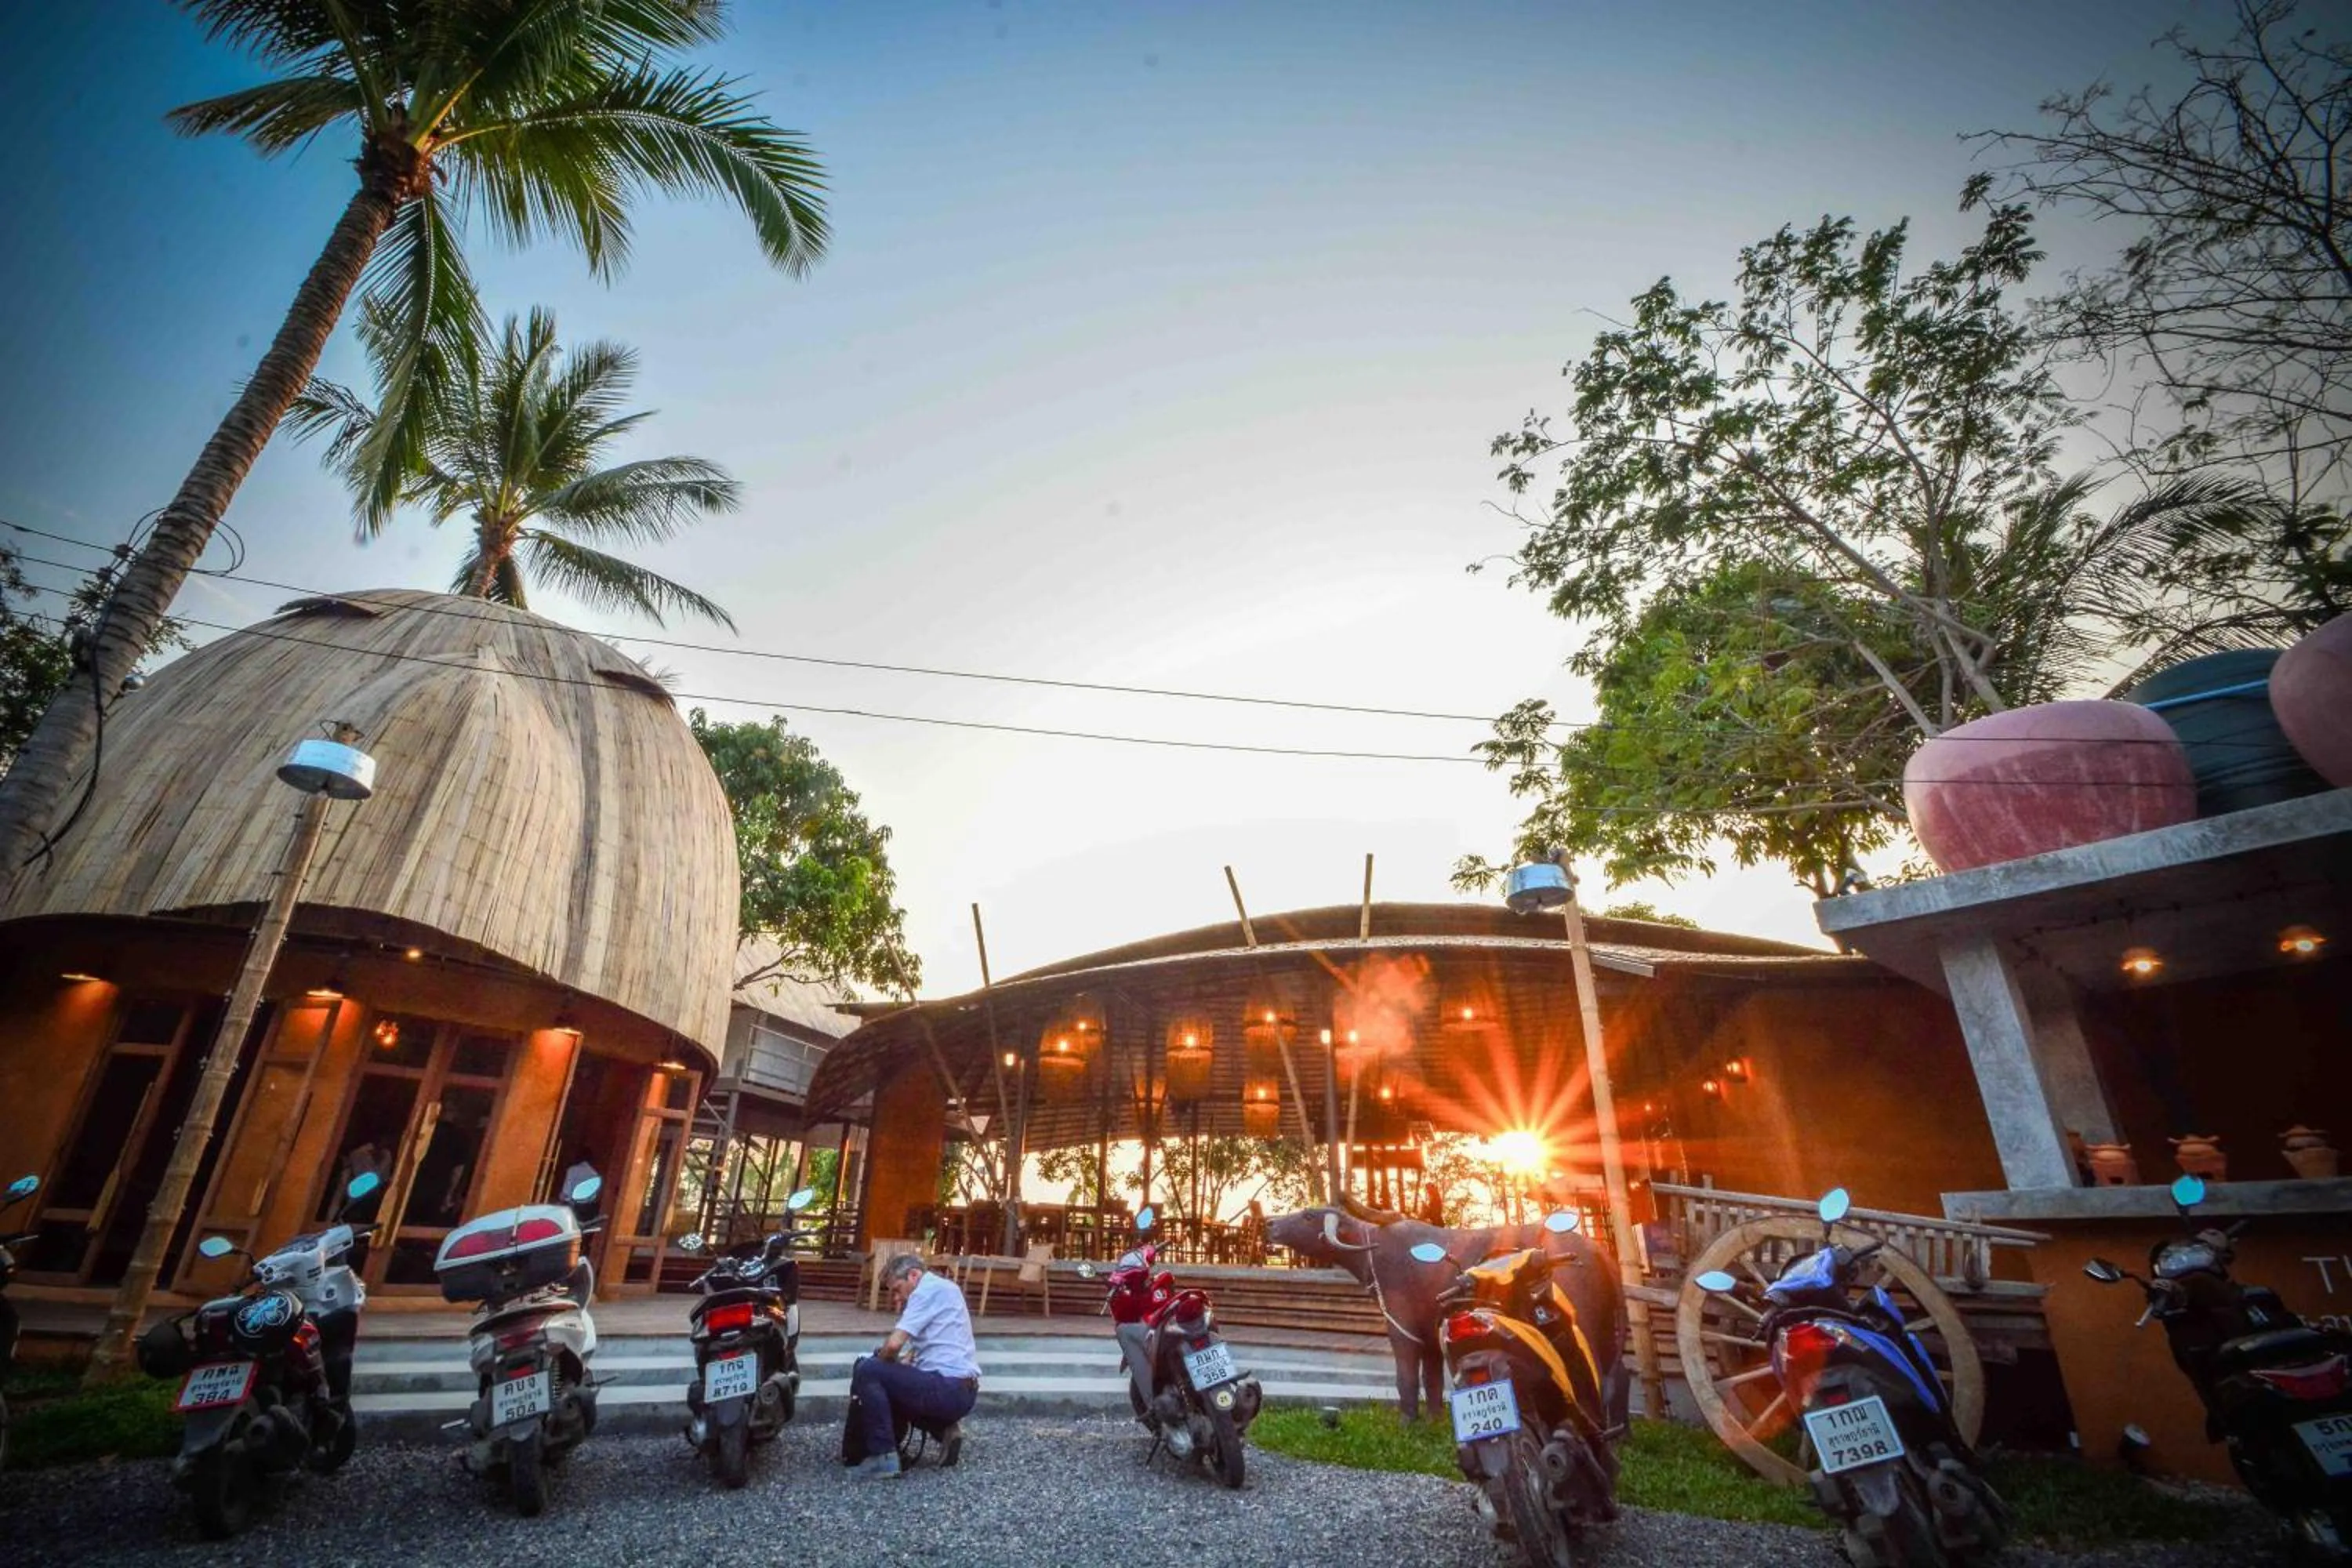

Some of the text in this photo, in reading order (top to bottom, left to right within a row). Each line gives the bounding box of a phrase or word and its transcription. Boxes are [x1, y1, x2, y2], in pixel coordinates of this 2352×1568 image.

[1203, 1368, 1227, 1384] 358
[1471, 1417, 1503, 1436] 240
[1832, 1440, 1889, 1465] 7398
